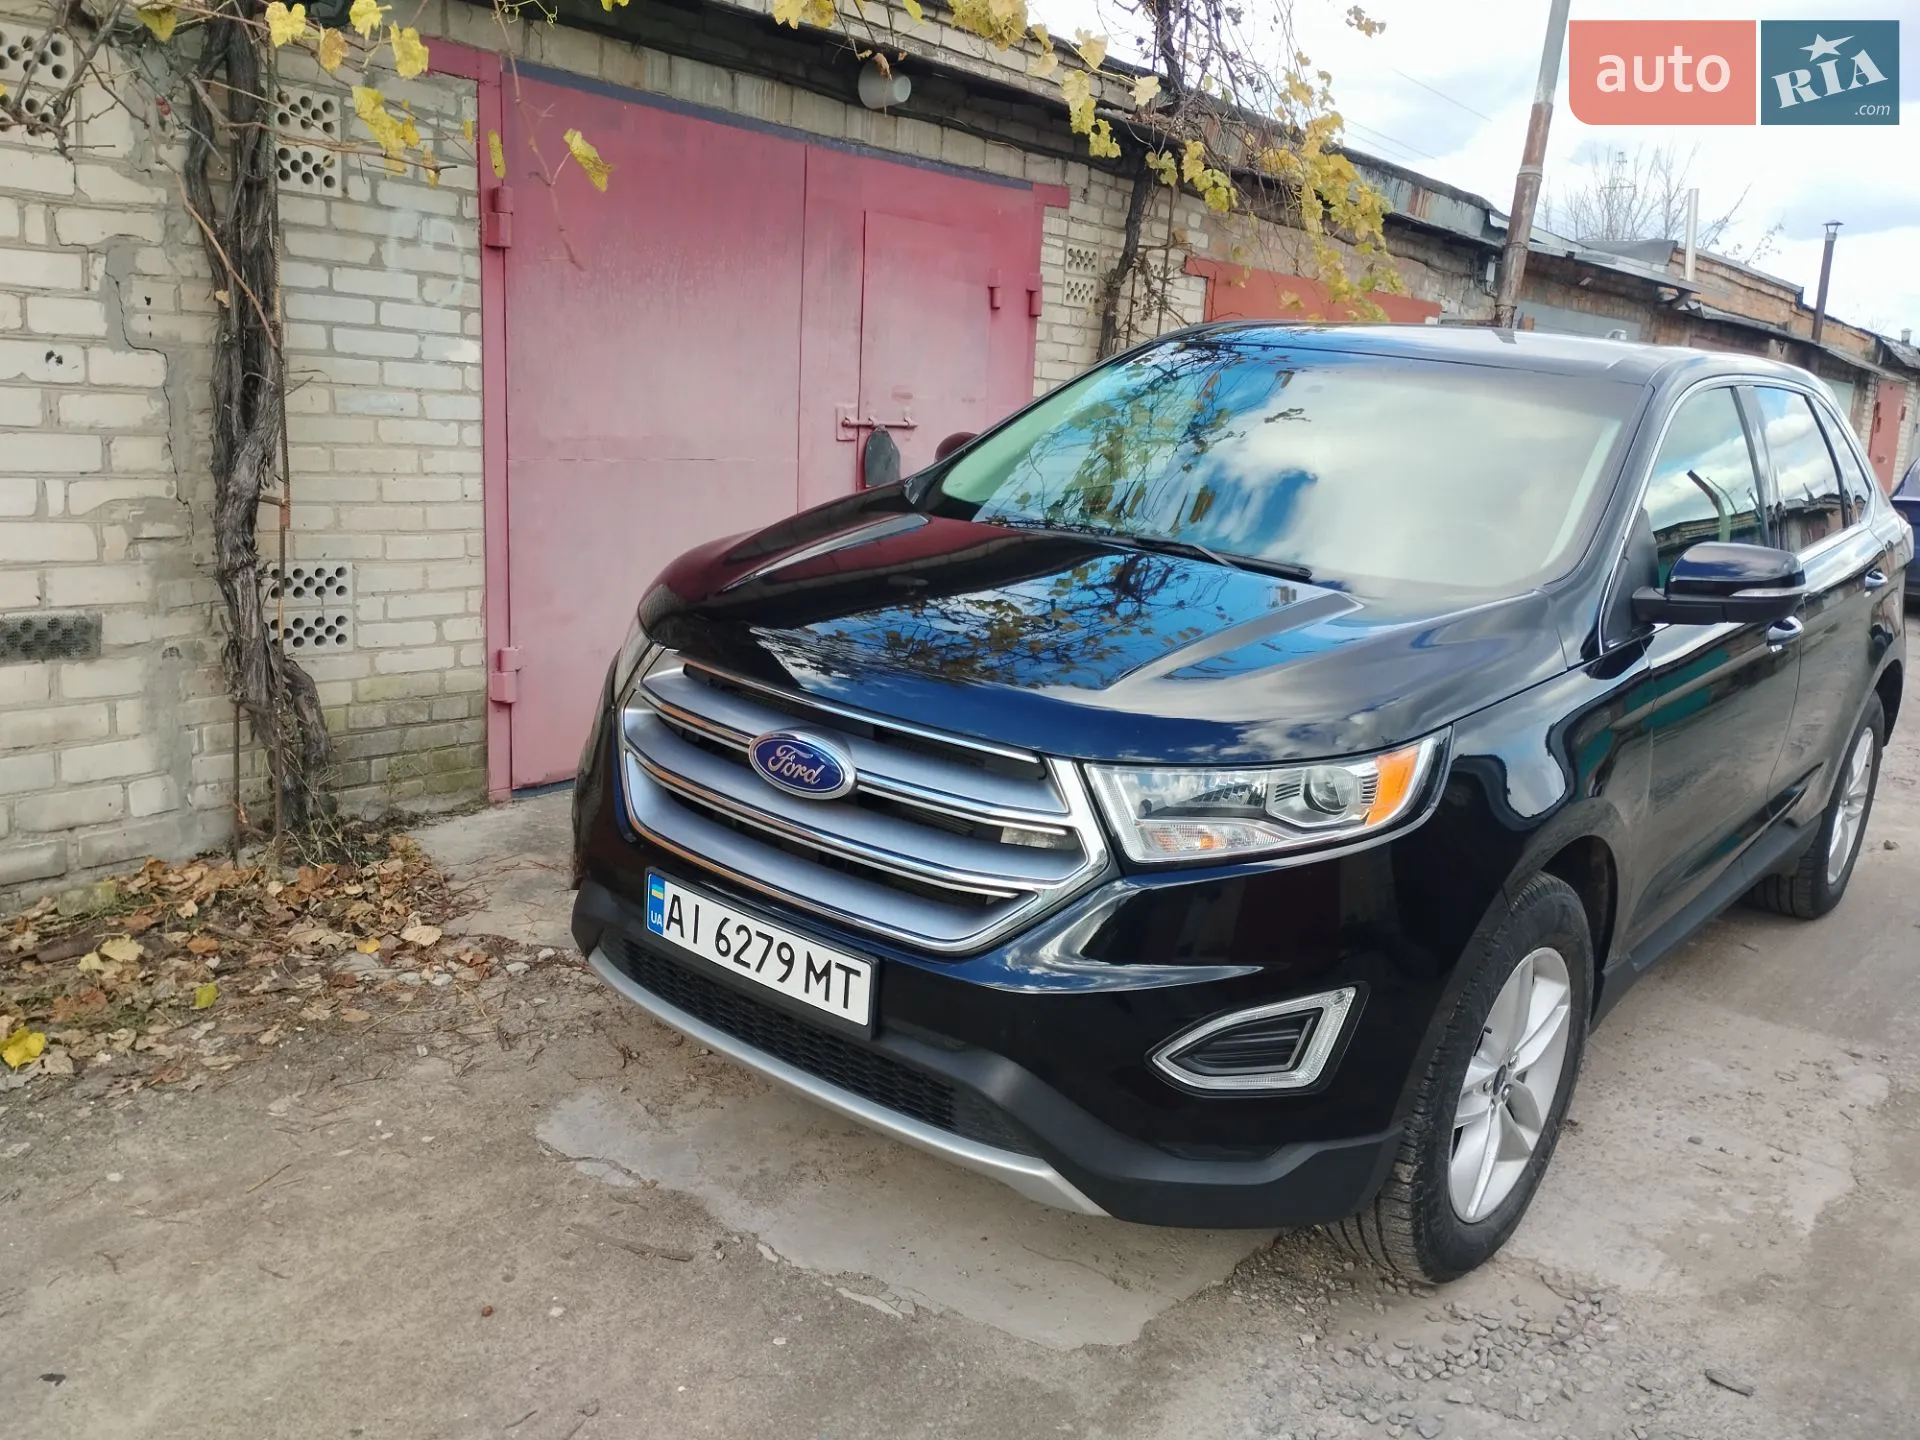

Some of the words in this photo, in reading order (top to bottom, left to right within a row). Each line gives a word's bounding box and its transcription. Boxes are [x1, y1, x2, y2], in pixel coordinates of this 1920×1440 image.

[767, 744, 826, 785] Ford
[650, 909, 663, 928] UA
[665, 893, 700, 945] AI
[714, 916, 796, 984] 6279
[804, 950, 862, 1010] MT
